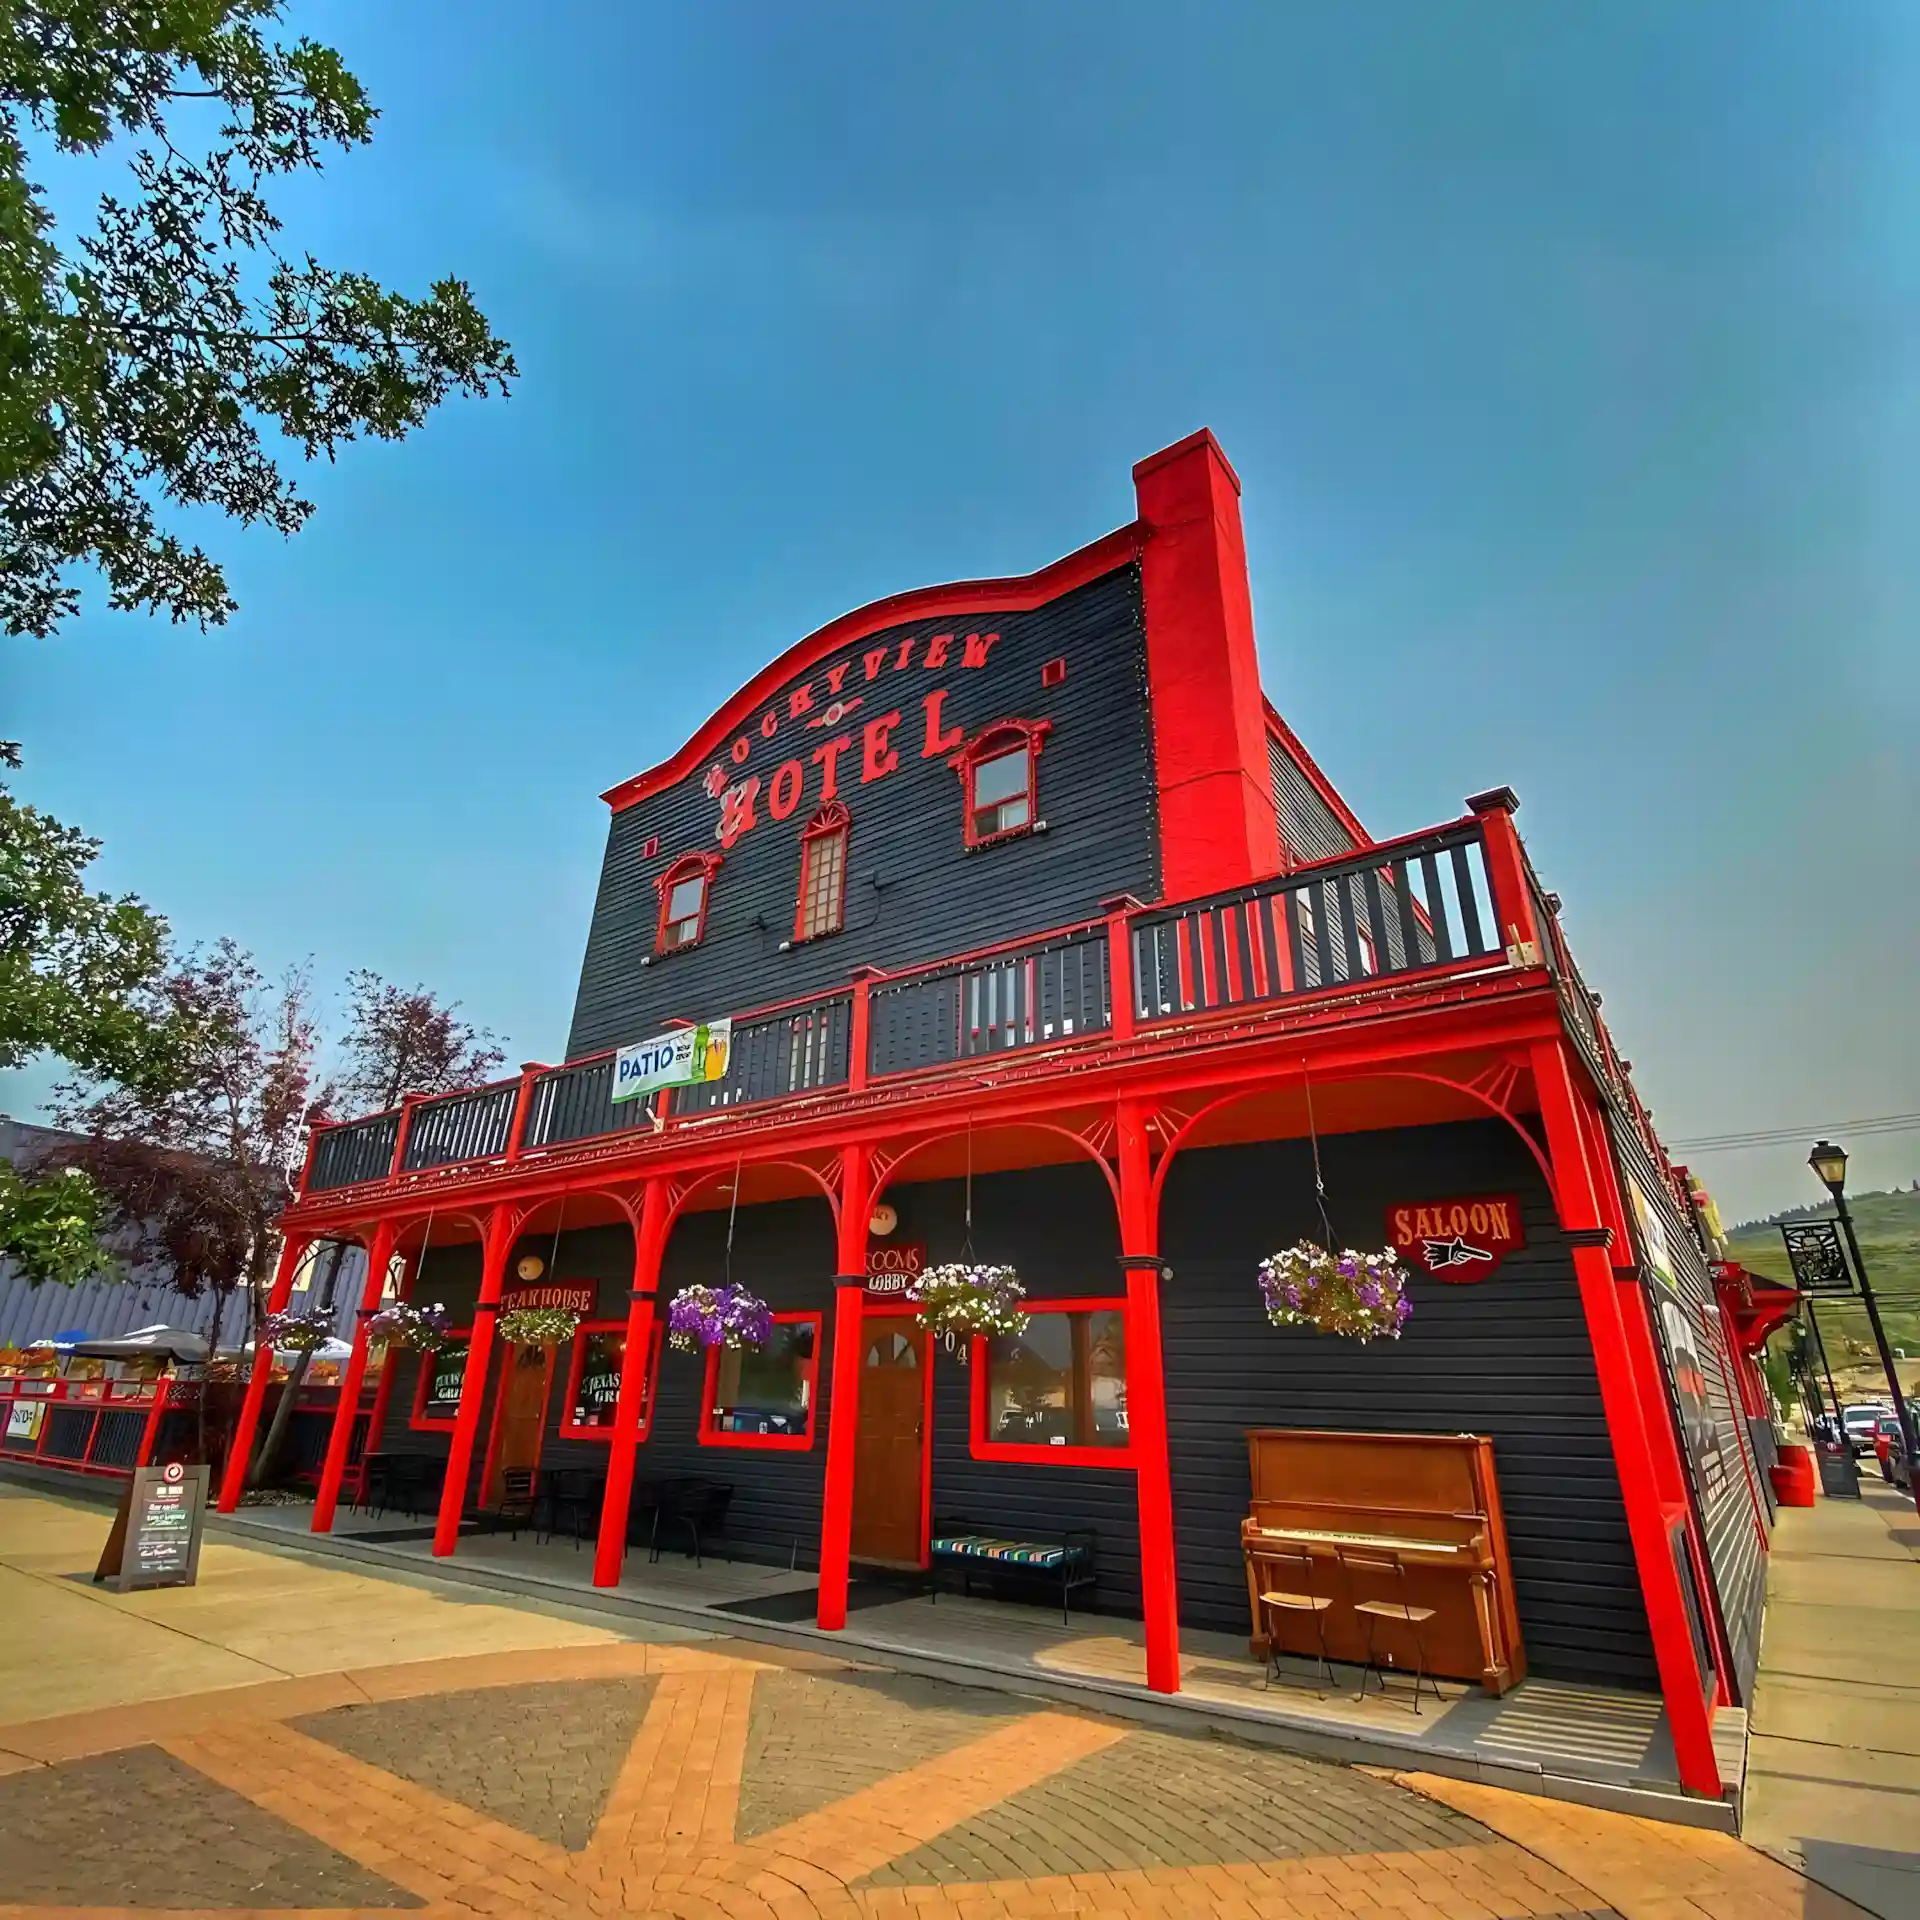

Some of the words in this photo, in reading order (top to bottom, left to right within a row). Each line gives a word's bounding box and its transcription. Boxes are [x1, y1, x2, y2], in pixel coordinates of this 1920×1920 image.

[716, 690, 963, 849] HOTEL
[619, 1046, 674, 1082] PATIO
[1395, 1203, 1511, 1246] SALOON
[500, 1287, 591, 1312] TEAKHOUSE
[869, 1273, 908, 1291] LOBBY
